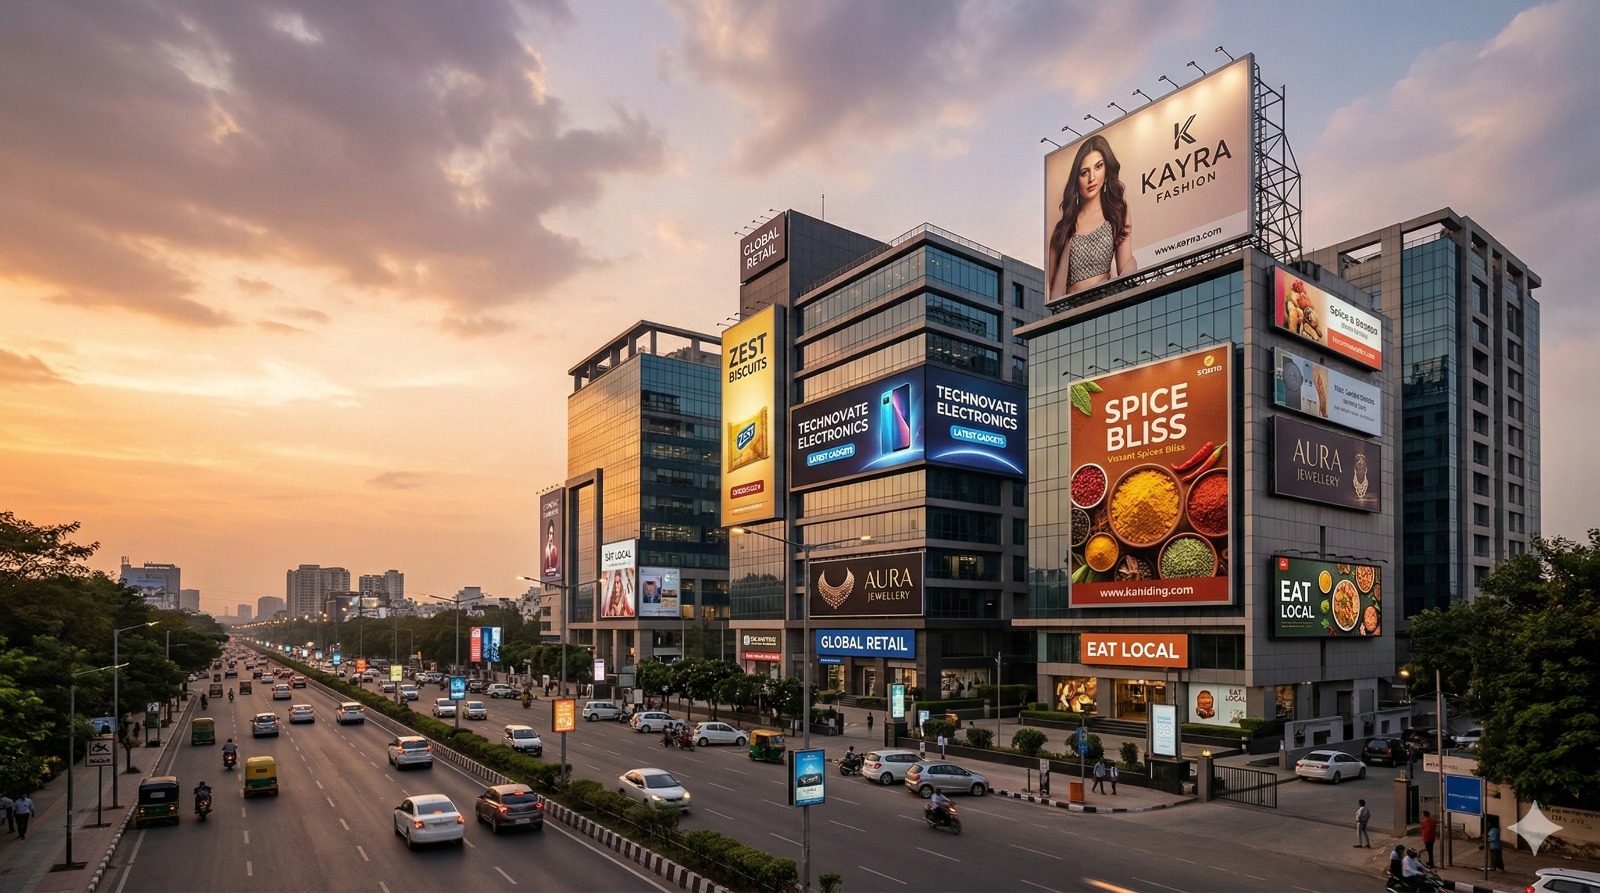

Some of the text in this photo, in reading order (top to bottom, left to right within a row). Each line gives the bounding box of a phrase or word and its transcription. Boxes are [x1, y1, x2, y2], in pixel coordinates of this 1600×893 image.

[1141, 139, 1232, 194] KAYRA
[1156, 171, 1216, 203] FASHION
[743, 226, 780, 256] GLOBAL
[746, 243, 777, 270] RETAIL
[729, 332, 767, 369] ZEST
[729, 356, 767, 383] BISCUITS
[936, 384, 1018, 416] TECHNOVATE
[1106, 383, 1188, 424] SPICE
[797, 401, 869, 435] TECHNOVATE
[937, 401, 1018, 431] ELECTRONICS
[797, 418, 869, 450] ELECTRONICS
[1107, 413, 1187, 452] BLISS
[1136, 448, 1164, 460] Spices
[1165, 444, 1186, 453] Bliss
[1292, 438, 1343, 474] AURA
[1296, 468, 1341, 488] JEWELLERY
[614, 549, 632, 561] LOCAL
[864, 567, 914, 590] AURA
[1281, 580, 1312, 603] EAT
[867, 591, 911, 603] JEWELLERY
[1281, 604, 1315, 619] LOCAL
[821, 635, 908, 651] GLOBAL RETAIL
[1087, 641, 1180, 659] EAT LOCAL
[1225, 695, 1247, 703] LOCAL
[1229, 688, 1242, 696] EAT
